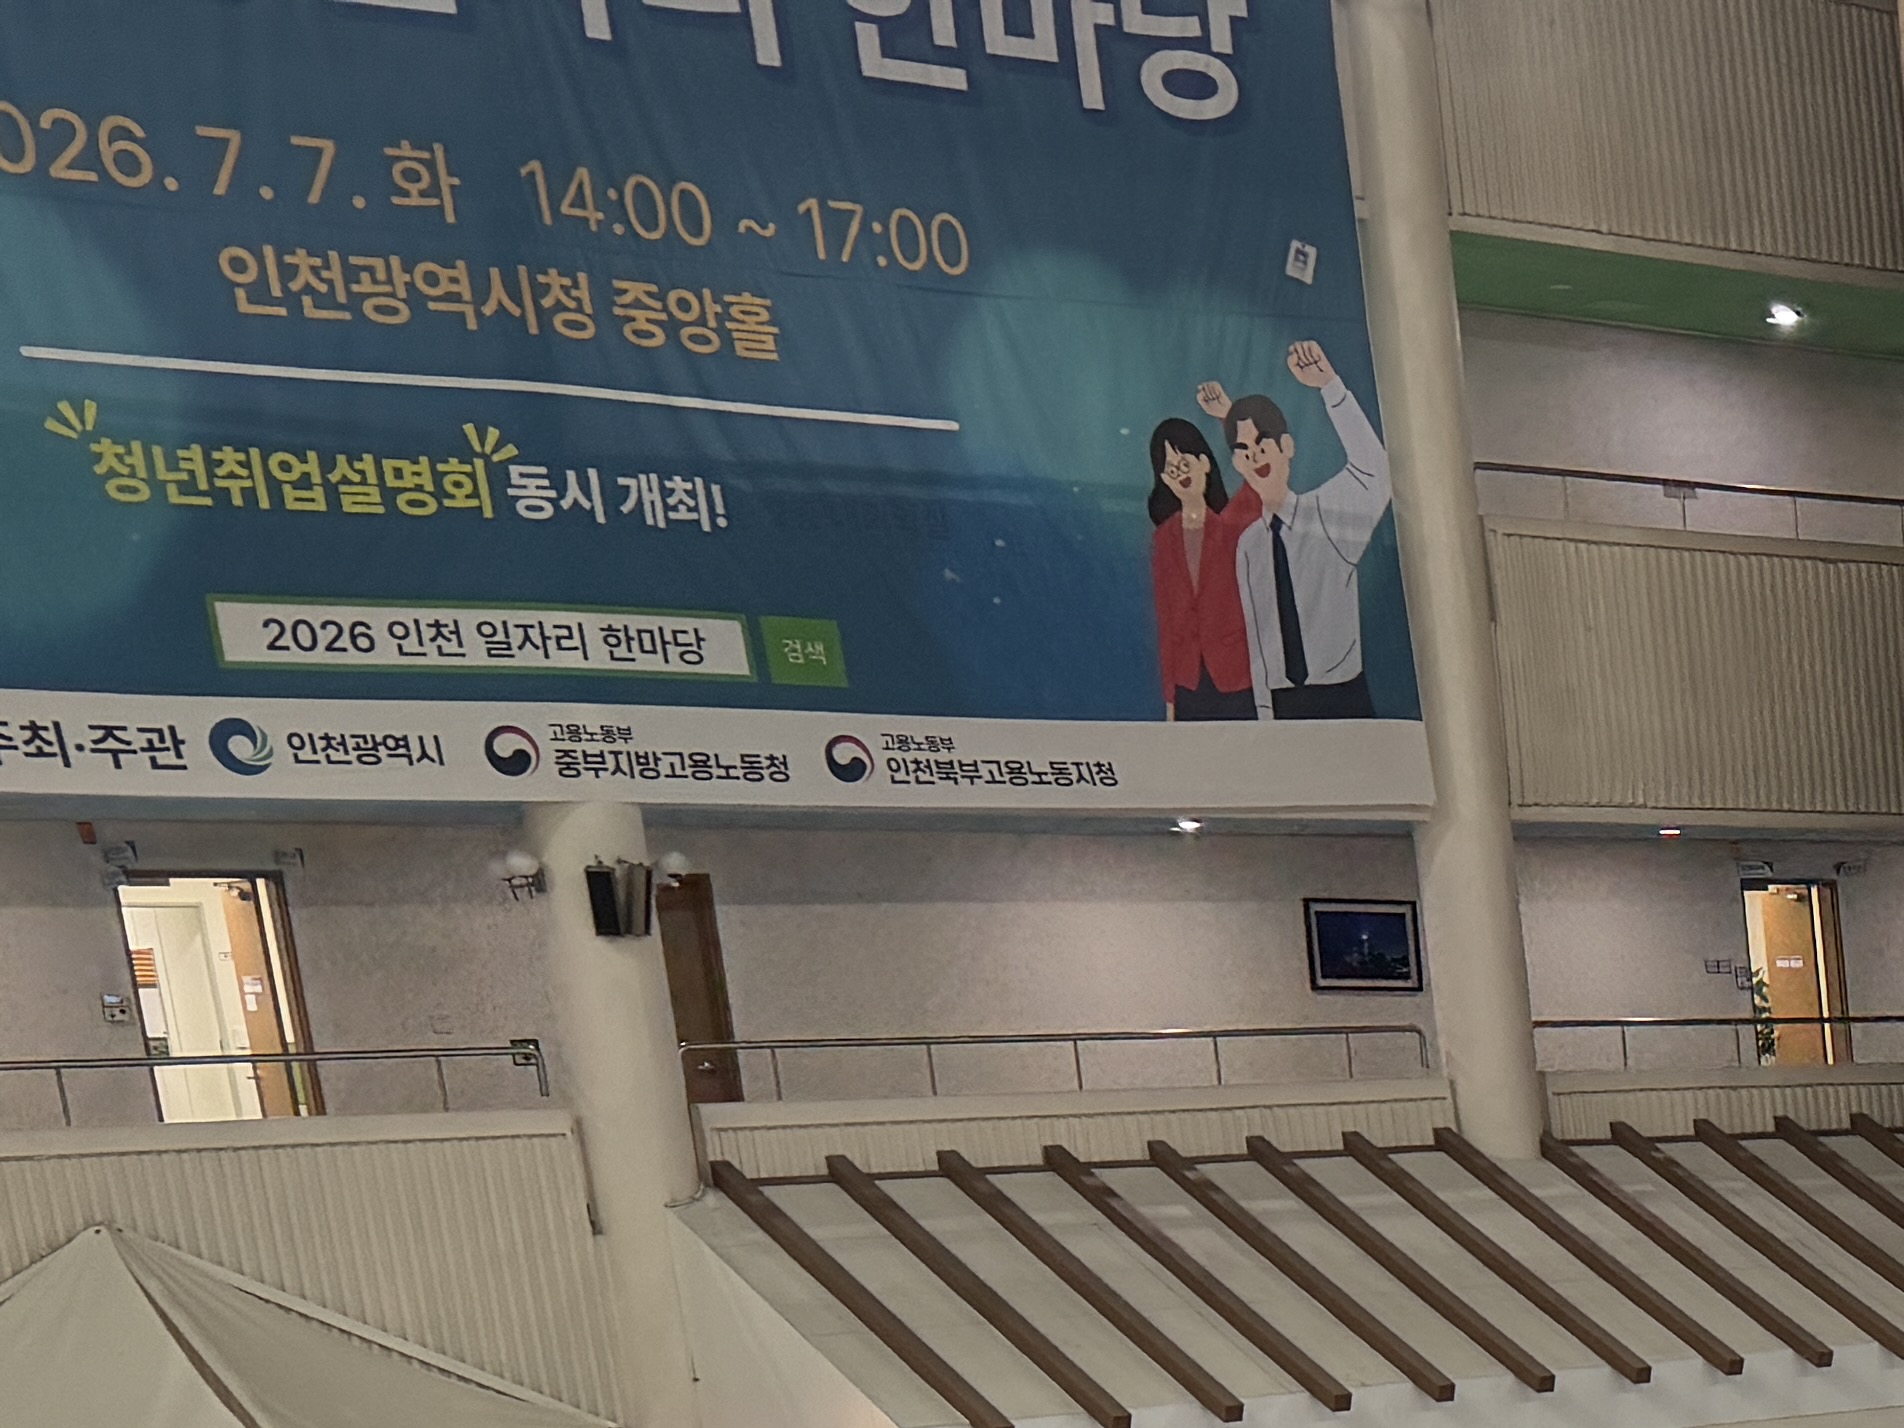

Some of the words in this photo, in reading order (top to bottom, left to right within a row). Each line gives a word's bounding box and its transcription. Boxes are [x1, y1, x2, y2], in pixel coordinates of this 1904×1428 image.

[383, 140, 460, 223] 화
[519, 159, 712, 246] 14:00
[797, 198, 970, 276] 17:00
[218, 244, 597, 340] 인천광역시청
[611, 277, 780, 361] 중앙홀
[90, 437, 495, 519] 청년취업설명회
[506, 463, 606, 524] 동시
[618, 470, 729, 532] 개최!
[261, 616, 376, 655] 2026
[387, 617, 467, 659] 인천
[476, 622, 588, 662] 일자리
[601, 625, 706, 666] 한마당
[781, 638, 829, 667] 검색
[286, 732, 446, 768] 인천광역시
[548, 722, 634, 744] 고용노동부
[881, 733, 956, 754] 고용노동부
[554, 749, 791, 783] 중부지방고용노동청
[886, 757, 1119, 789] 인천북부고용노동지청
